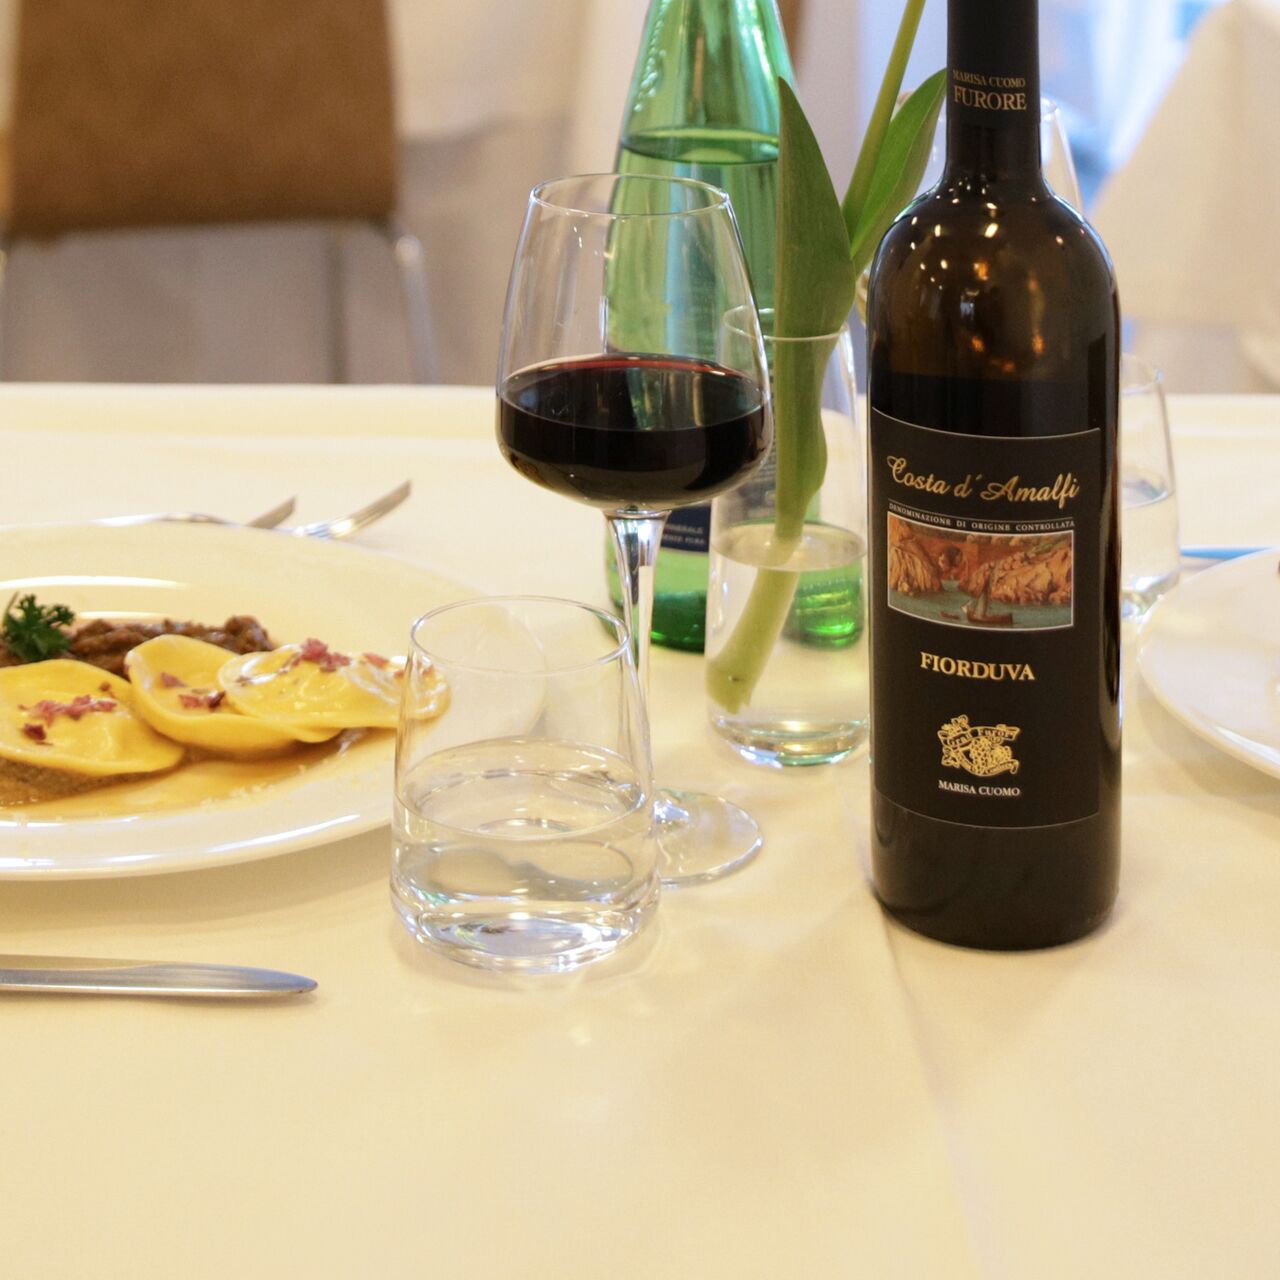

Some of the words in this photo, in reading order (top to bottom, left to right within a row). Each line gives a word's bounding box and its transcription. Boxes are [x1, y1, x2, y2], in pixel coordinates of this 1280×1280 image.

[953, 70, 987, 85] MARISA
[989, 77, 1025, 88] CUOMO
[954, 86, 1027, 110] FURORE
[887, 455, 951, 495] Costa
[889, 502, 951, 526] DENOMINAZIONE
[956, 521, 967, 529] DI
[971, 522, 1011, 532] ORIGINE
[1016, 520, 1075, 532] CONTROLLATA
[920, 651, 1035, 680] FIORDUVA
[938, 780, 977, 794] MARISA
[978, 786, 1020, 797] CUOMO
